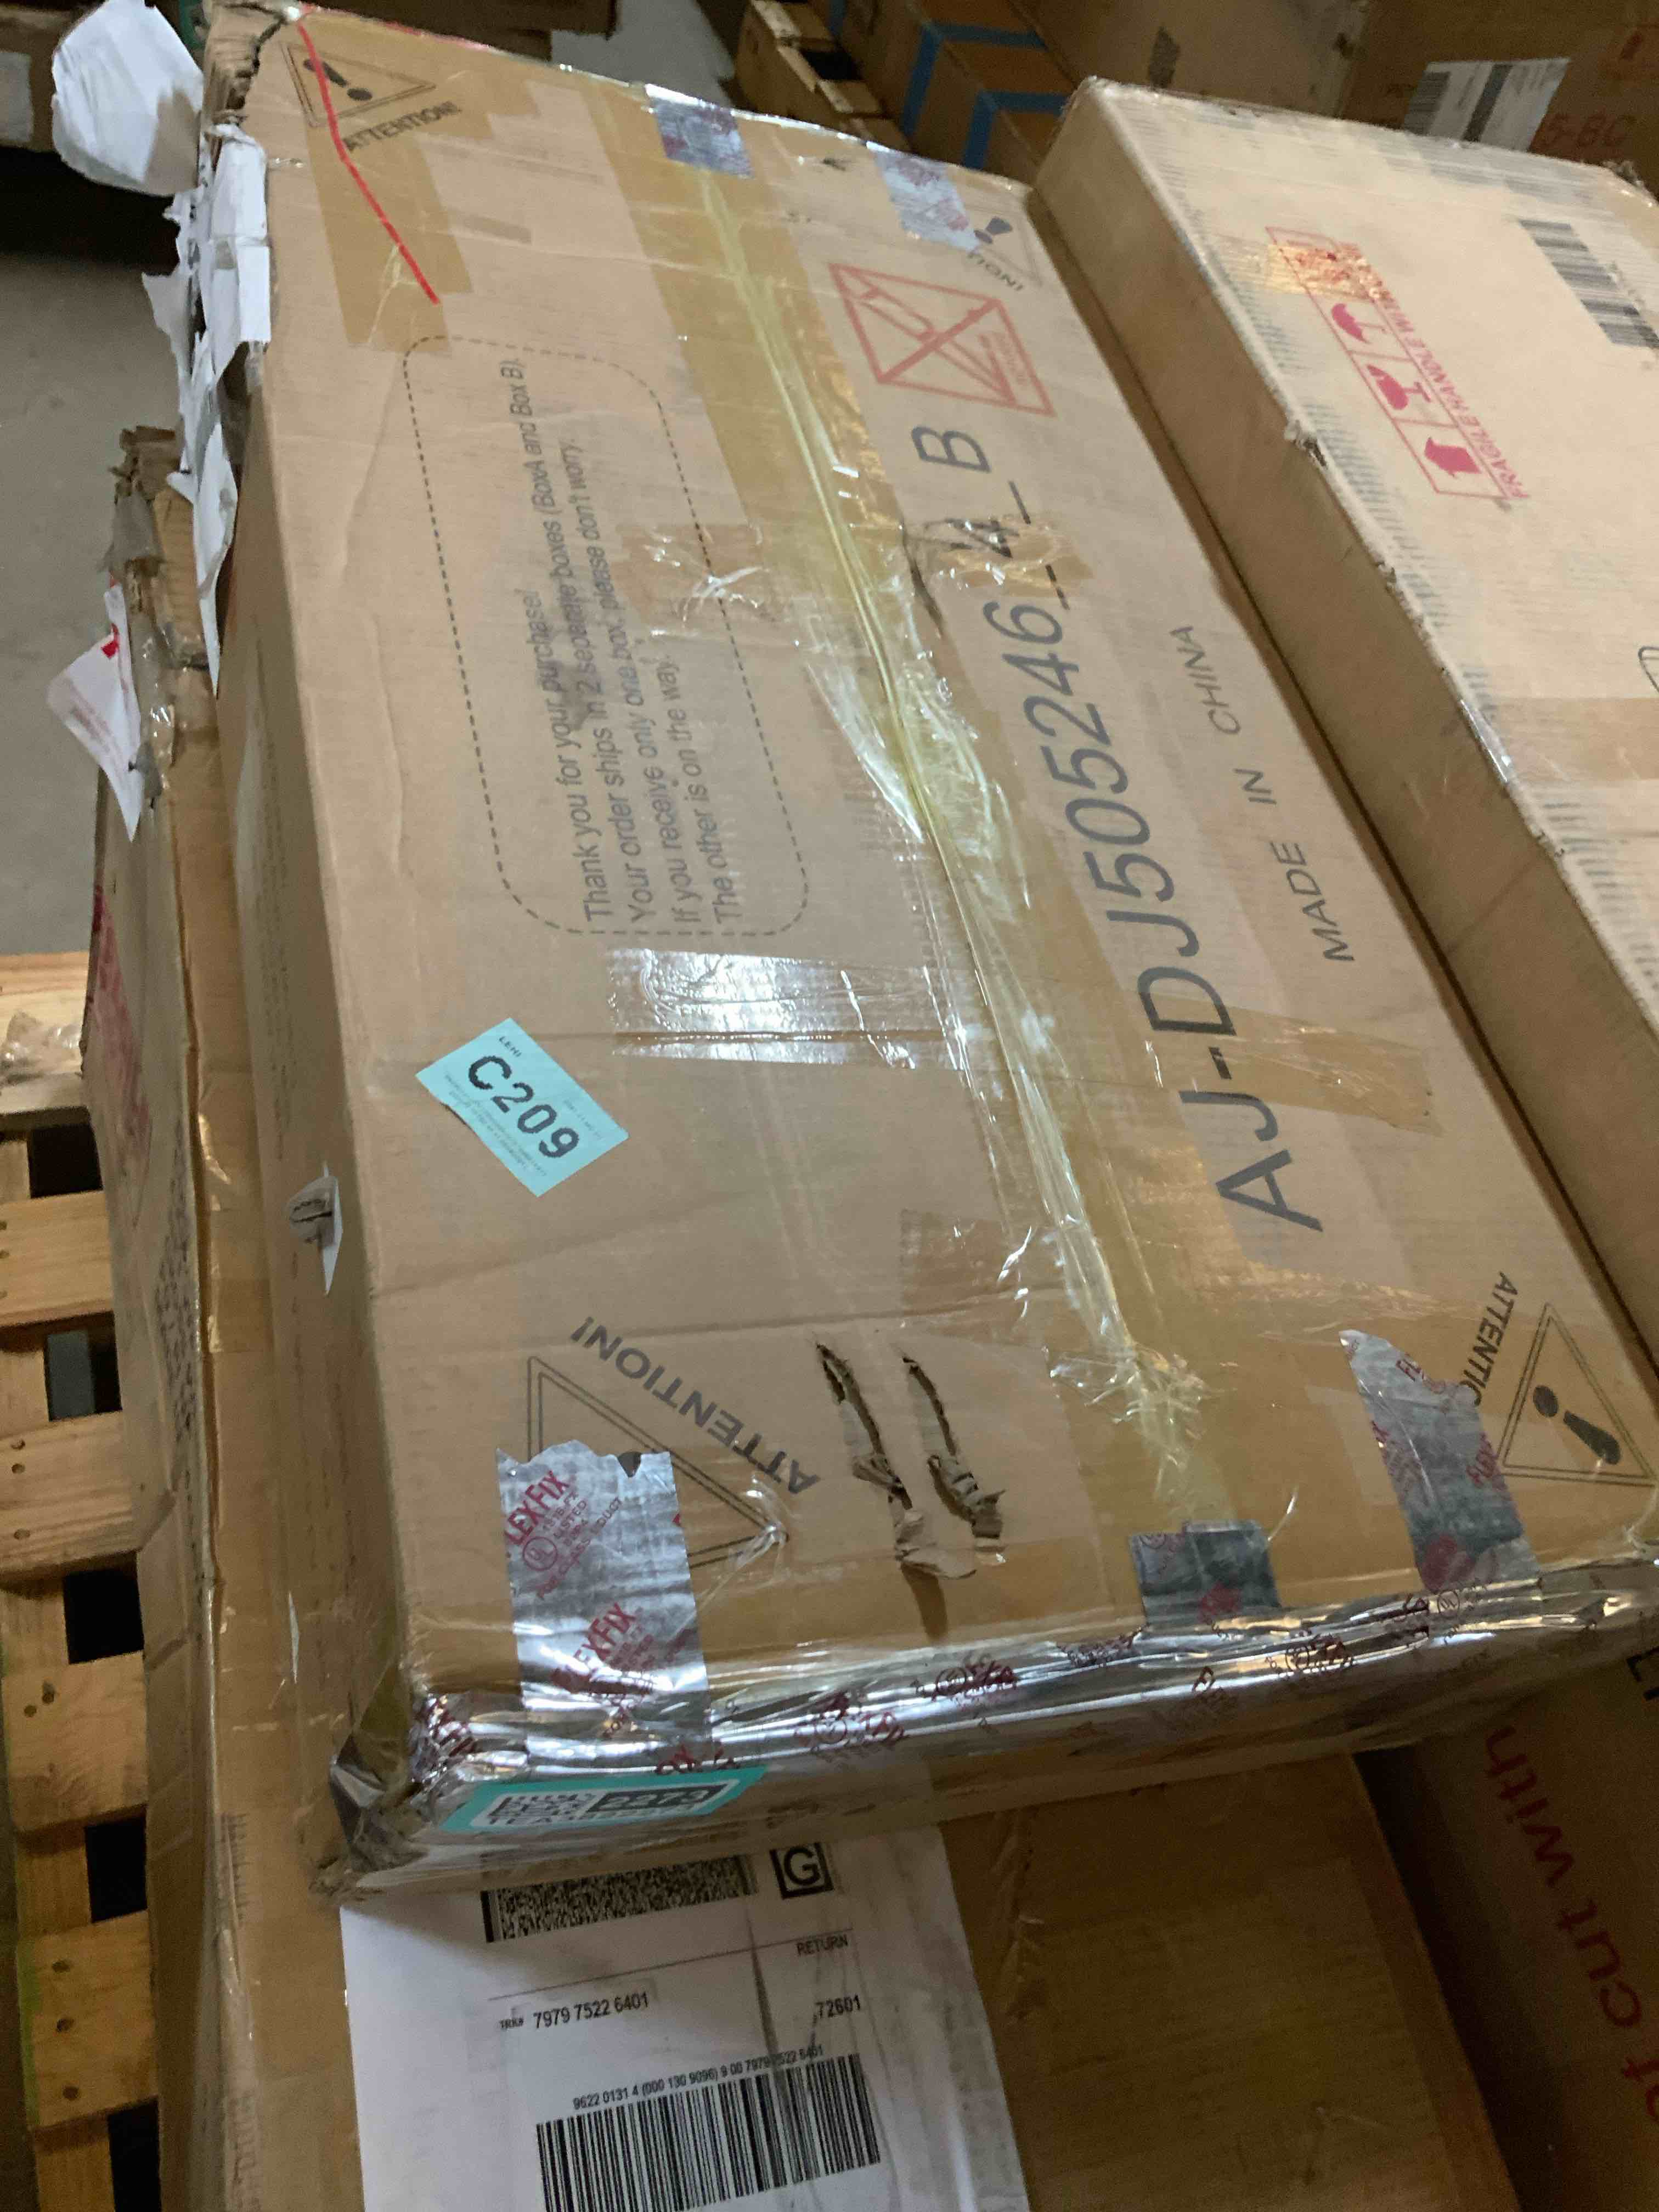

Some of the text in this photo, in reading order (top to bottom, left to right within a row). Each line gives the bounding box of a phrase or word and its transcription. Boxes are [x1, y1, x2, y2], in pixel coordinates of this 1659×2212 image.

[509, 383, 533, 417] Box
[518, 422, 542, 456] and
[567, 494, 601, 541] don't
[543, 521, 575, 580] boxes
[586, 545, 625, 611] please
[558, 584, 597, 674] separate
[618, 666, 644, 707] one
[546, 698, 582, 749] your
[586, 701, 608, 721] in
[667, 708, 693, 742] the
[592, 727, 625, 787] ships
[627, 712, 658, 759] only
[557, 755, 583, 786] for
[678, 749, 702, 777] on
[567, 793, 602, 837] you
[642, 766, 682, 850] receive
[684, 783, 710, 802] is
[1169, 625, 1355, 961] MADE IN CHINA
[608, 793, 641, 857] order
[693, 808, 727, 869] other
[572, 845, 613, 922] Thank
[625, 863, 657, 923] Your
[666, 857, 703, 902] you
[712, 877, 742, 924] The
[670, 906, 702, 923] If
[467, 1055, 580, 1159] C209
[570, 1316, 821, 1494] ATTENTION!
[1484, 1726, 1575, 1888] with
[783, 1846, 821, 1886] G
[797, 1933, 848, 1957] RETURN
[1557, 1898, 1643, 2028] cut
[533, 2006, 571, 2029] 7979
[574, 1999, 611, 2021] 7522
[614, 1991, 649, 2013] 6401
[603, 2087, 629, 2104] 0131
[631, 2084, 639, 2097] 4
